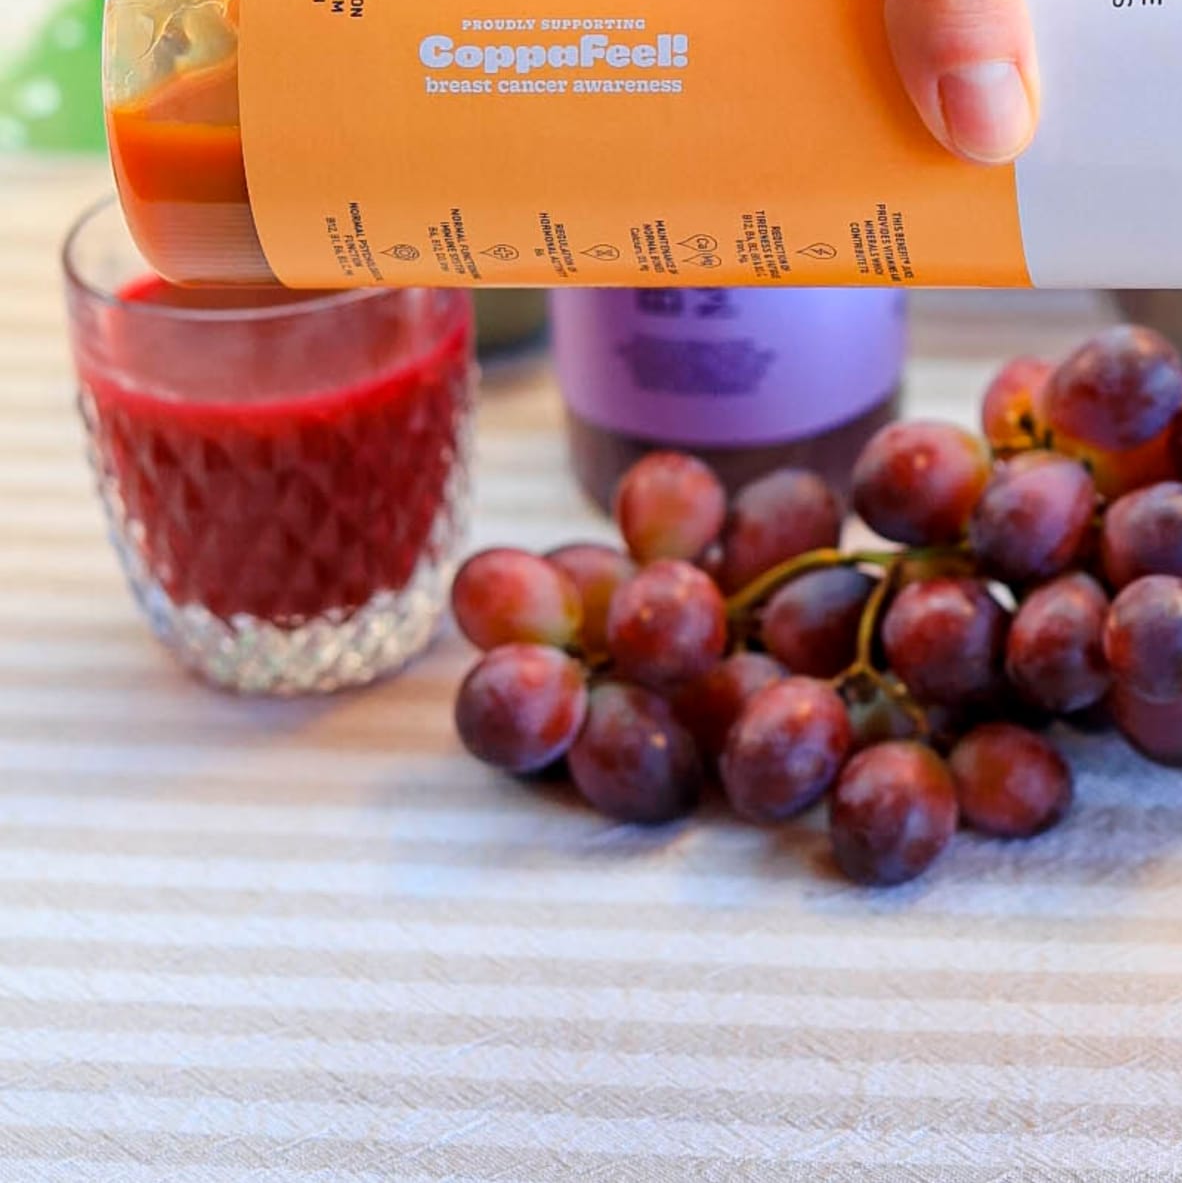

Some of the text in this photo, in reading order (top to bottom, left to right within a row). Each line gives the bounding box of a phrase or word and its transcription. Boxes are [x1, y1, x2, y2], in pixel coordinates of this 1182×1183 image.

[461, 18, 646, 31] PROUDLY SUPPORTING
[418, 33, 689, 73] CoppaFeel!
[425, 77, 682, 93] breast cancer awareness
[349, 202, 366, 238] NORMAL
[451, 208, 465, 243] NORMAL
[539, 212, 557, 255] HORMONAL
[643, 224, 657, 254] NORMAL
[755, 210, 773, 253] TIREDNESS
[864, 220, 879, 257] MINERALS
[876, 203, 891, 245] PROVIDES
[892, 212, 904, 232] THIS
[555, 223, 574, 266] REGULATION
[655, 220, 676, 269] MAINTENANCE
[770, 226, 788, 264] REDUCTION
[849, 221, 867, 266] CONTRIBUTE
